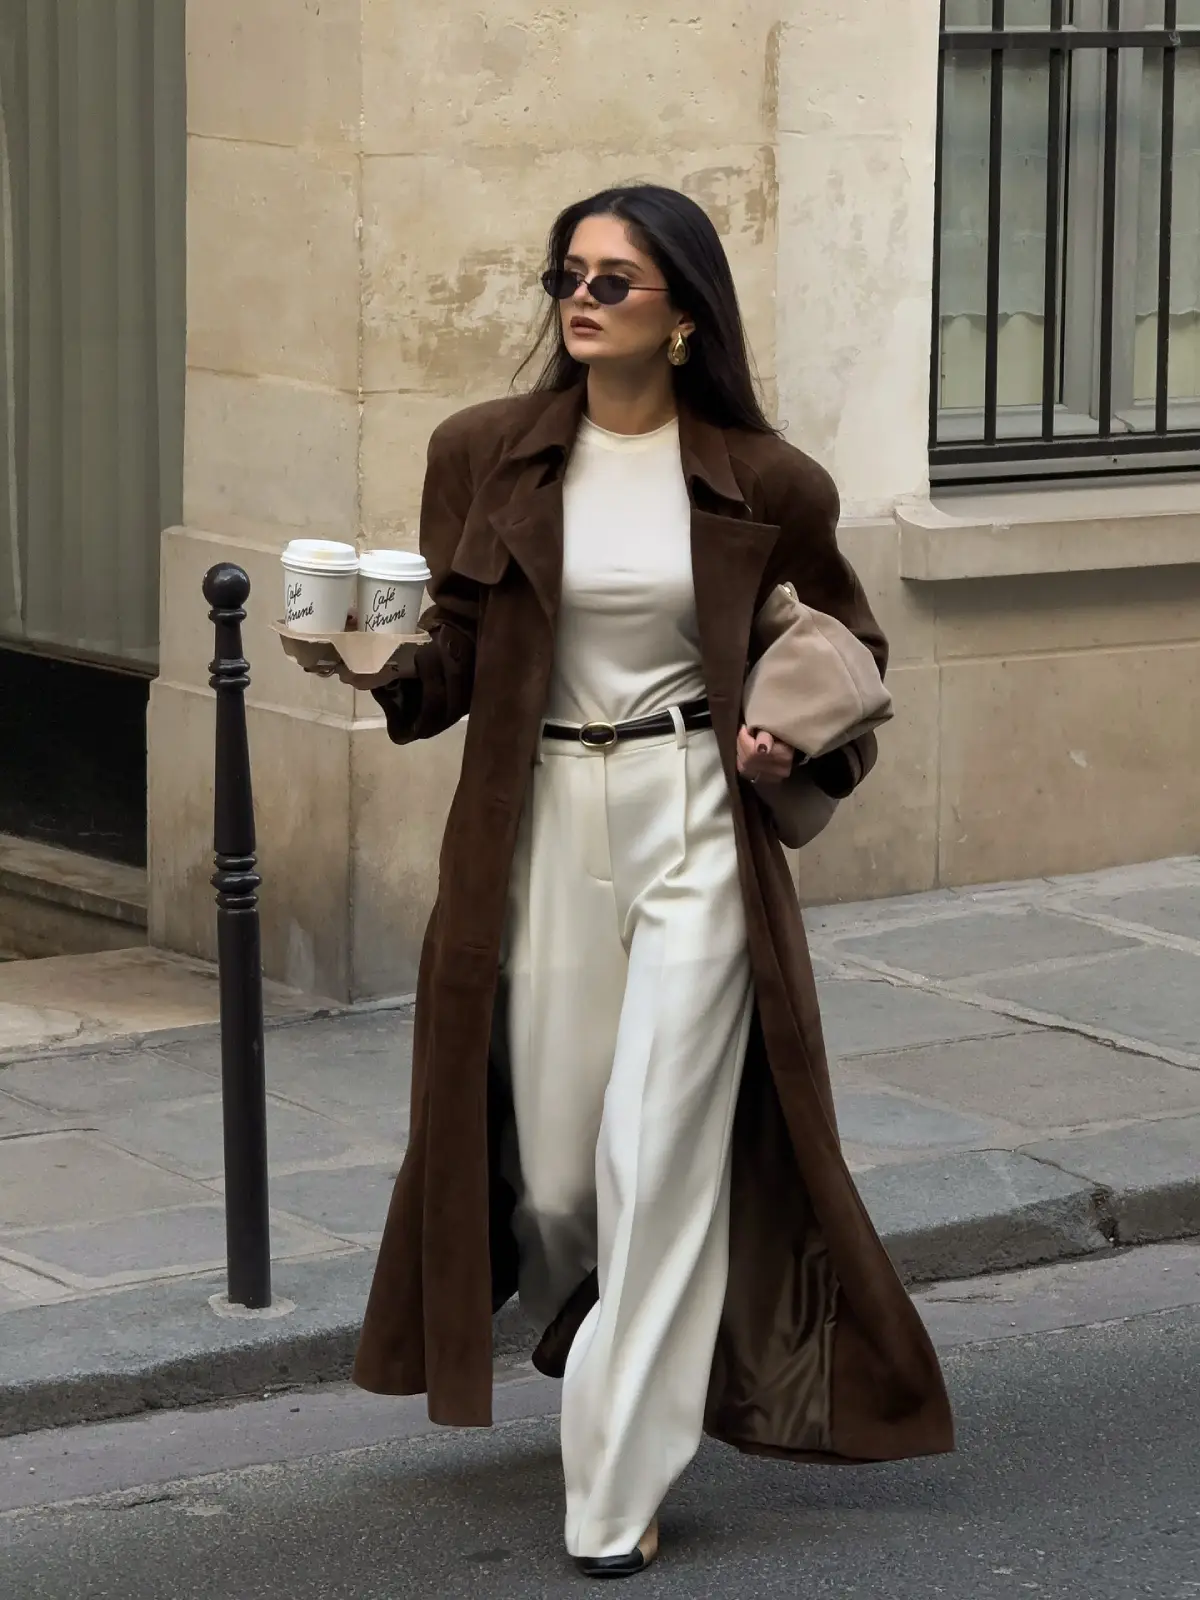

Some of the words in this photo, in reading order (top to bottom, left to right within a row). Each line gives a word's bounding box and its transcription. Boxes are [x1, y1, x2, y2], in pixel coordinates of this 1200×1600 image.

[287, 582, 302, 607] Café
[373, 587, 396, 612] Café
[365, 604, 406, 632] Kitsuné
